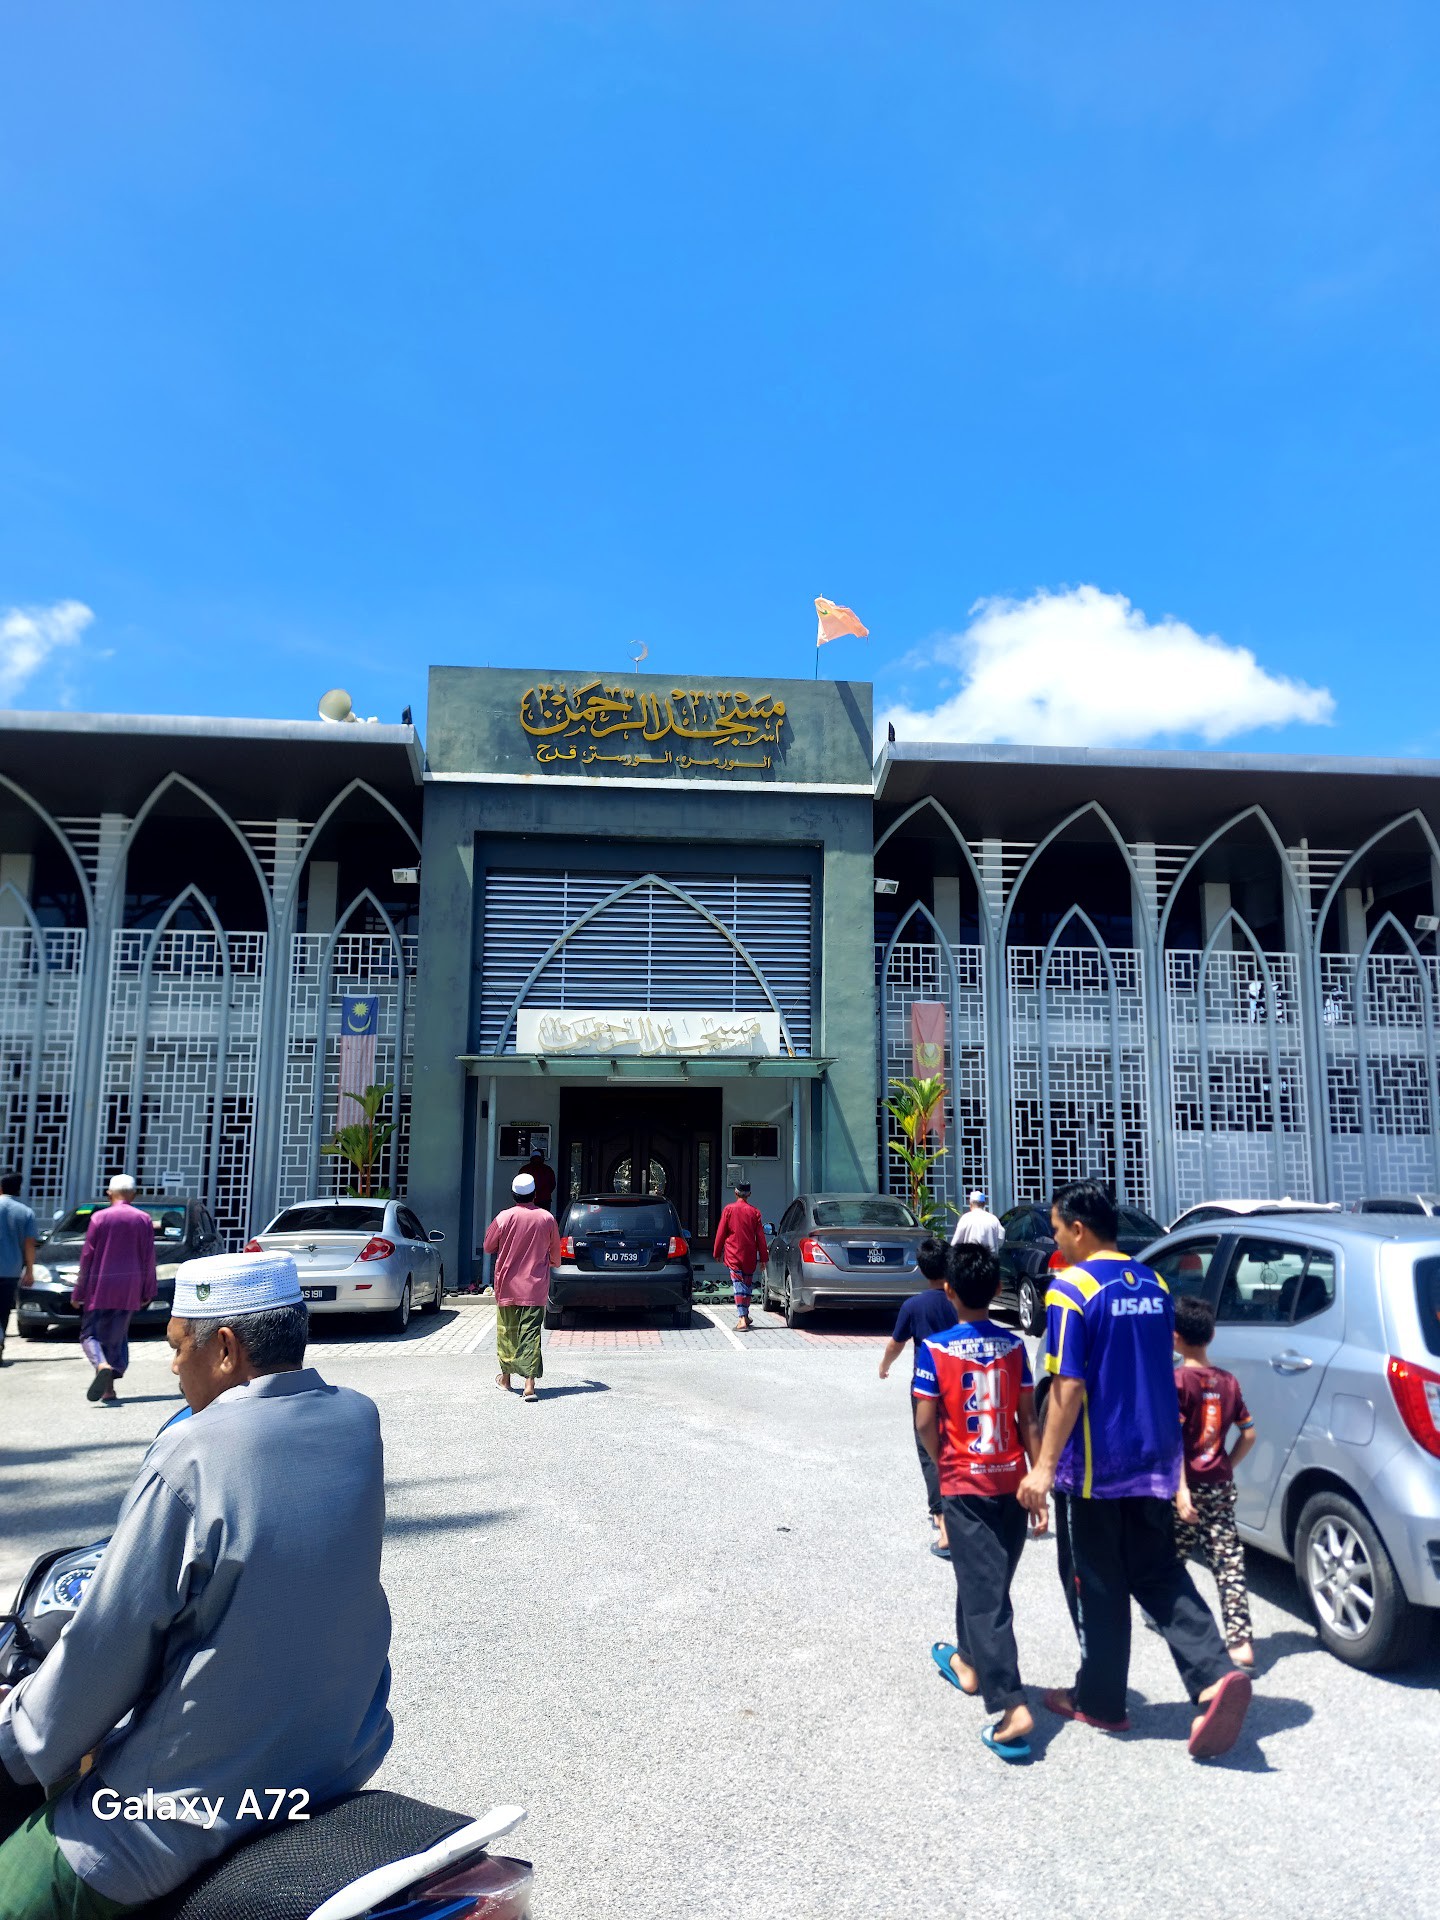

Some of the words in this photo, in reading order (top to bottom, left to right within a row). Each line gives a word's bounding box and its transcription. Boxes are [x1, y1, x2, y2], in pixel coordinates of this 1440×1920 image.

[590, 1204, 601, 1213] P
[868, 1248, 883, 1256] KDJ
[605, 1253, 618, 1261] PJD
[620, 1253, 638, 1261] 7539
[1111, 1297, 1164, 1317] USAS
[947, 1342, 980, 1356] SILAT
